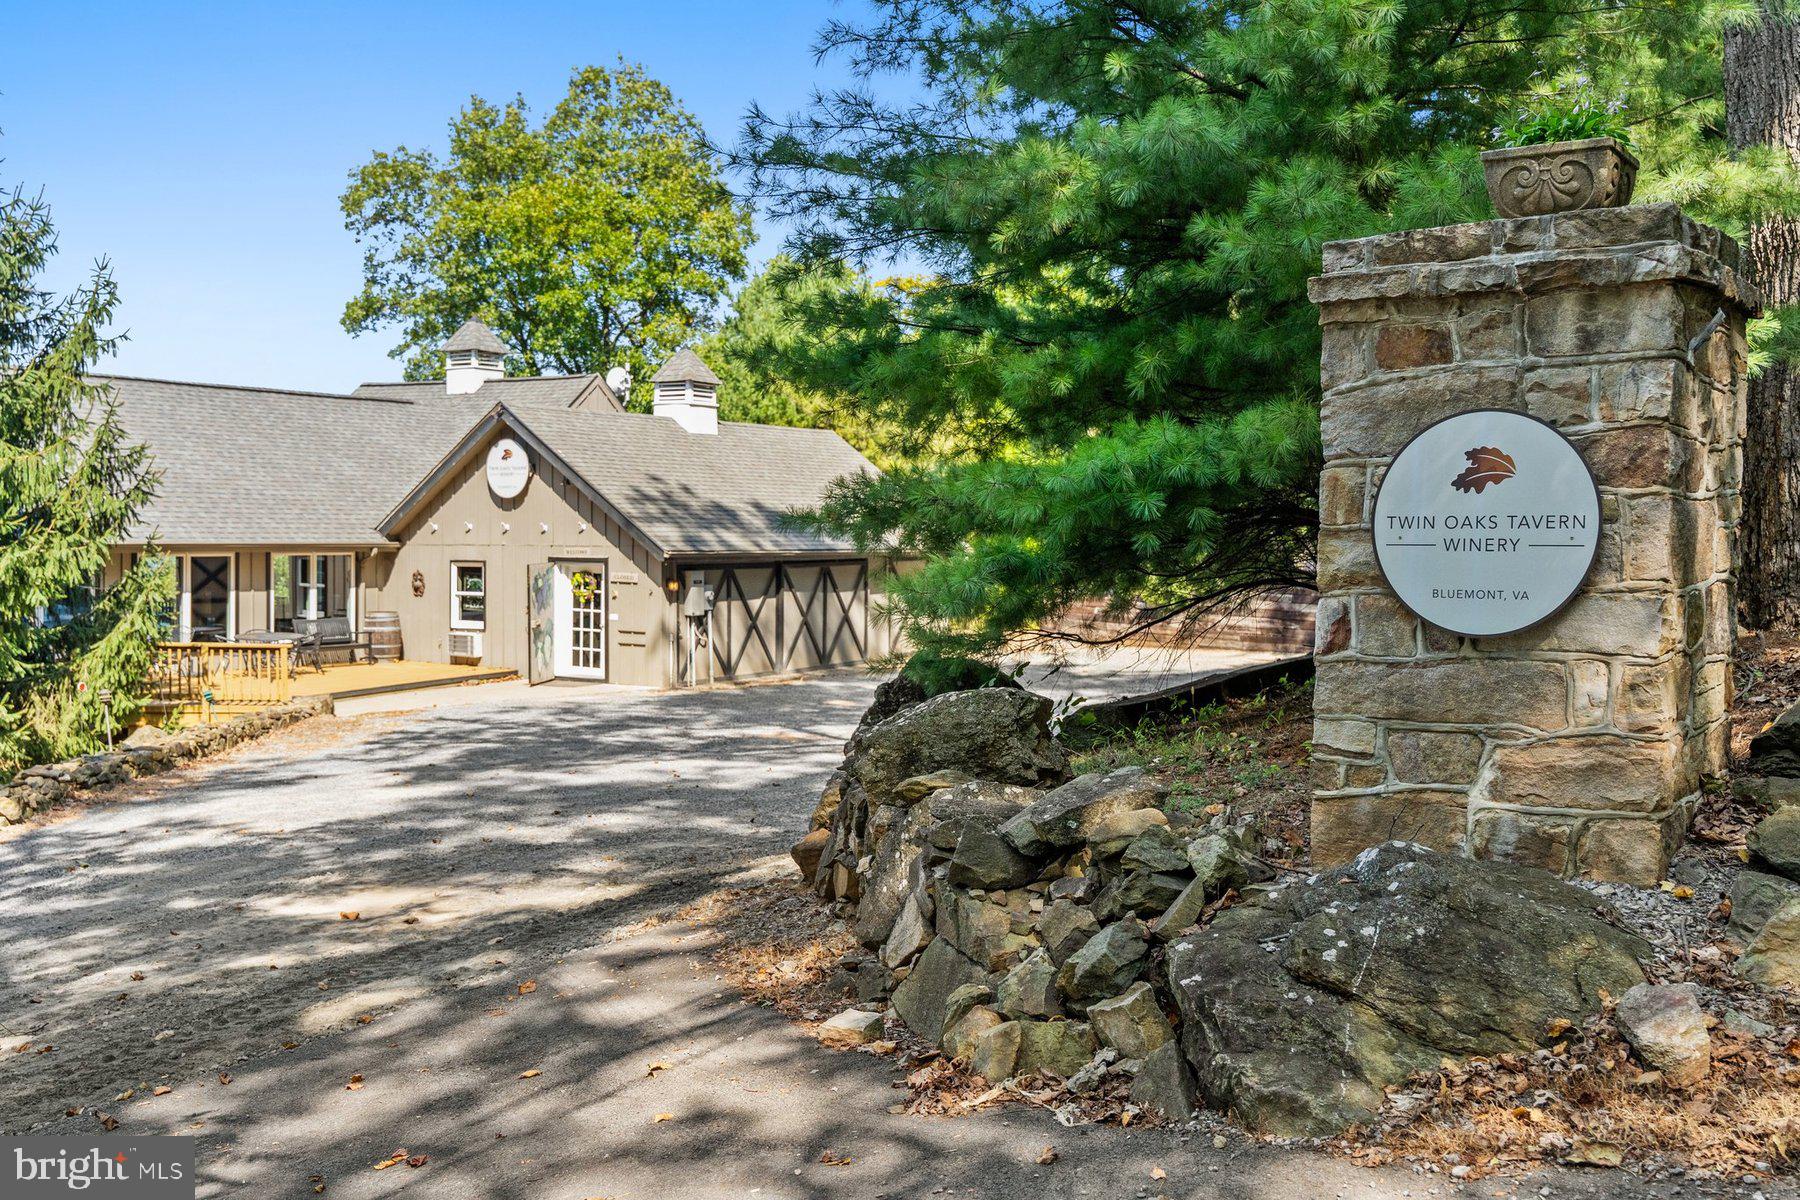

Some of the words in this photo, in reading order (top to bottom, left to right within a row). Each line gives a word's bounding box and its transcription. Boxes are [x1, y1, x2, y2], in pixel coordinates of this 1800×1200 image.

[1387, 515, 1436, 529] TWIN
[1444, 515, 1498, 529] OAKS
[1507, 515, 1586, 529] TAVERN
[1443, 538, 1521, 552] WINERY
[1432, 589, 1507, 601] BLUEMONT,
[1512, 590, 1529, 600] VA
